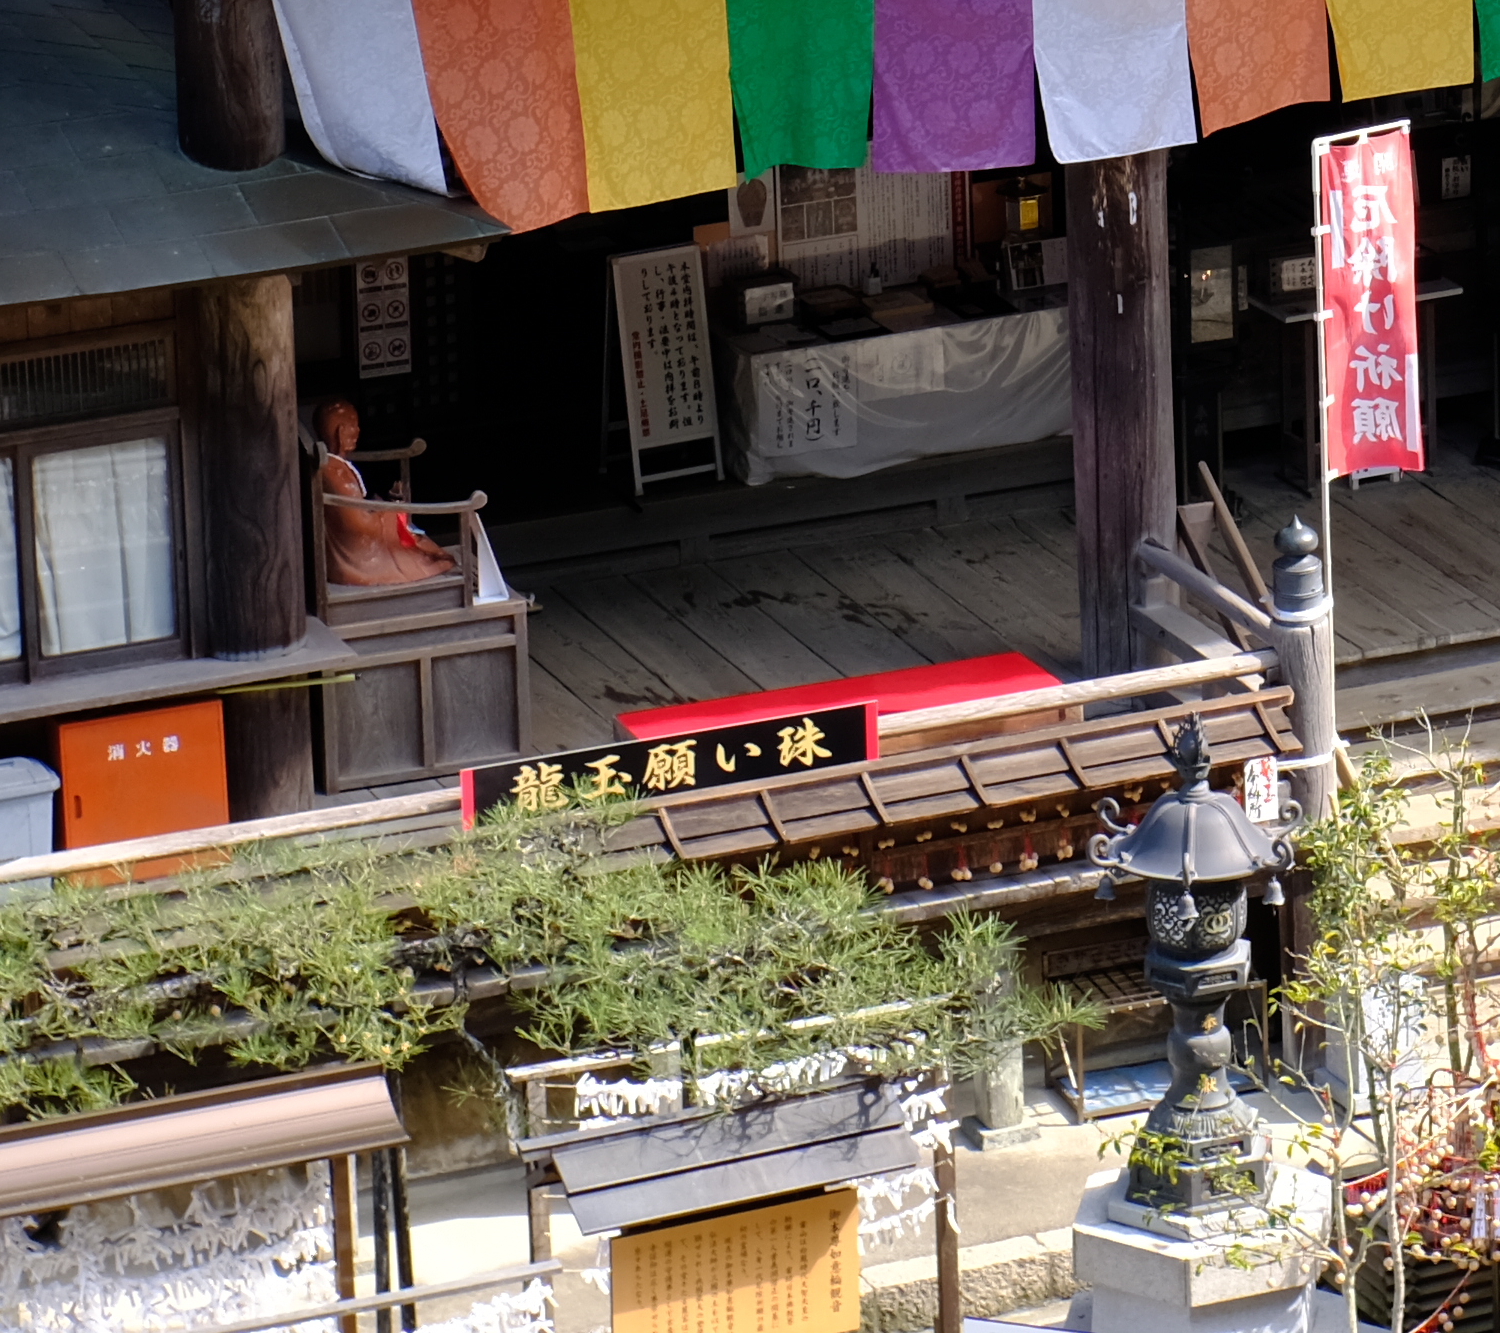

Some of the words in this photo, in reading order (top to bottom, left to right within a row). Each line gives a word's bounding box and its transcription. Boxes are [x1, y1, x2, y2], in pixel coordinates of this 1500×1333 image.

[107, 735, 179, 761] 消火器
[510, 718, 833, 814] 龍玉願い珠
